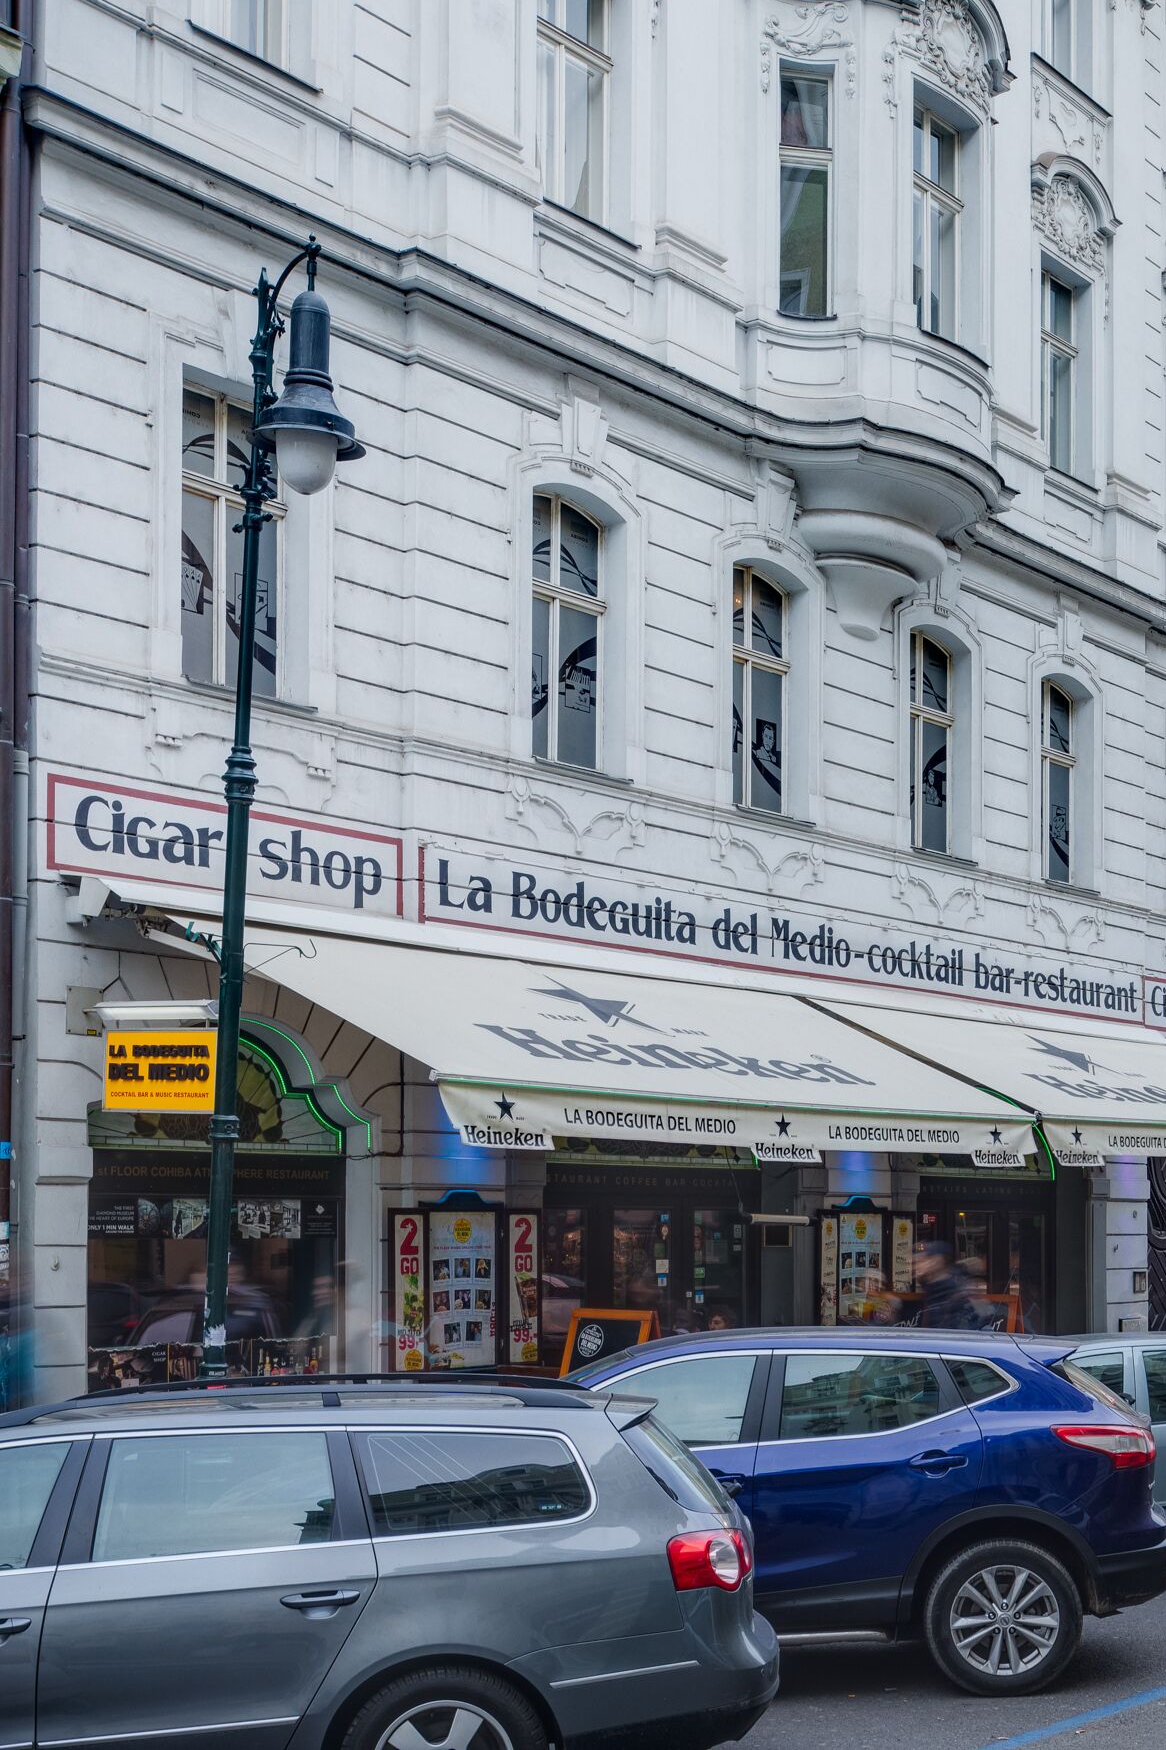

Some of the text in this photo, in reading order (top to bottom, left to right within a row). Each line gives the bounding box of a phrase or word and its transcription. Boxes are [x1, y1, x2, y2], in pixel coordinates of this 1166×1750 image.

[75, 795, 382, 909] Cigar shop
[438, 858, 493, 914] La
[511, 871, 697, 946] Bodeguita
[711, 908, 759, 955] del
[109, 1045, 210, 1058] LA BODEGUITA
[473, 1023, 877, 1086] Heineken
[108, 1063, 210, 1082] DEL MEDIO
[564, 1108, 736, 1134] LA BODEGUITA DEL MEDIO
[464, 1125, 546, 1147] Heineken
[828, 1125, 960, 1144] LA BODEGUITA DEL MEDIO
[1108, 1135, 1119, 1147] LA
[1120, 1136, 1162, 1149] BODEGUITA
[755, 1142, 816, 1160] Heineken
[975, 1150, 1019, 1165] Heineken
[1056, 1150, 1100, 1165] Heineken
[110, 1166, 149, 1177] FLOOR
[150, 1166, 191, 1177] COHIBA
[266, 1169, 330, 1180] RESTAURANT
[615, 1177, 658, 1187] COFFEE
[400, 1218, 418, 1255] 2
[515, 1218, 532, 1253] 2
[400, 1257, 419, 1275] GO
[515, 1255, 532, 1272] GO
